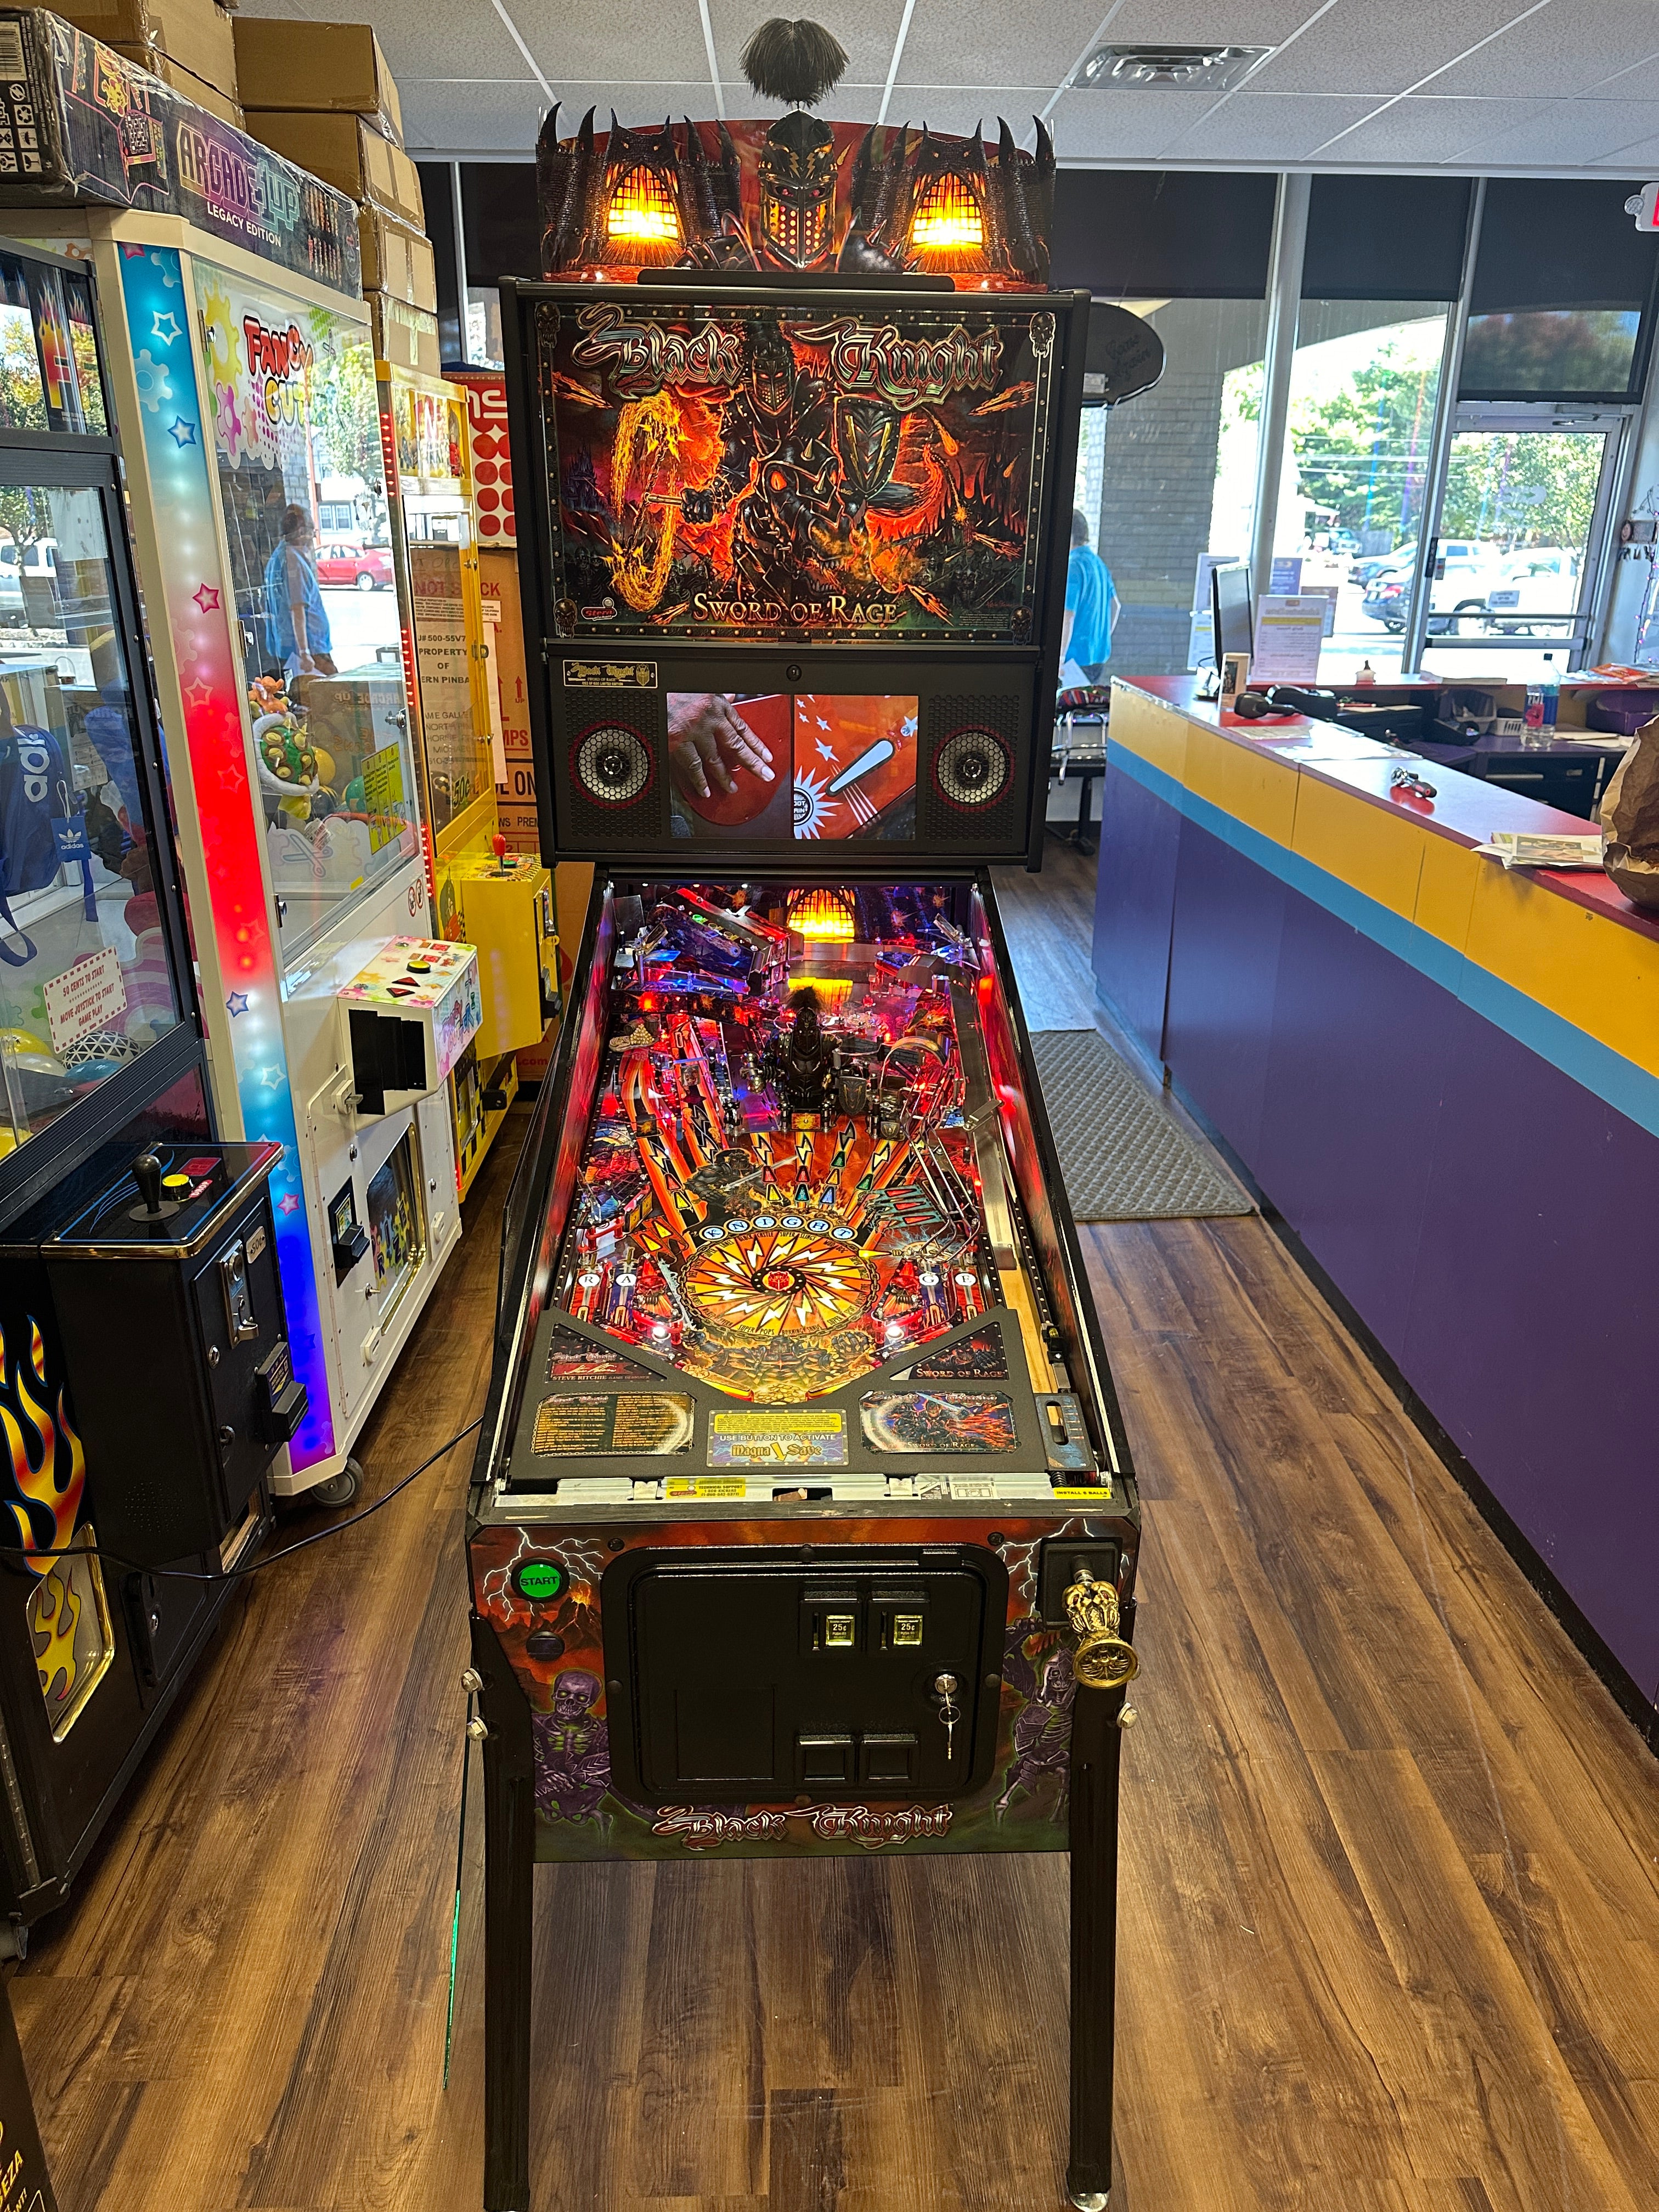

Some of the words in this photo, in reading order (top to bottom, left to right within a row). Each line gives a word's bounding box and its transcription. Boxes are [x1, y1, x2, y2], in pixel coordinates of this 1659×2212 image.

[206, 201, 245, 230] LEGACY
[246, 222, 282, 247] EDITION
[243, 314, 314, 380] FANCY
[571, 302, 743, 399] Black
[789, 315, 1005, 411] Knight
[264, 377, 311, 428] CUT
[692, 592, 782, 621] SWORD
[790, 603, 821, 623] OF
[830, 595, 899, 624] RAGE
[419, 648, 467, 656] PROPERTY
[63, 986, 70, 997] 50
[70, 977, 84, 992] CENTS
[86, 974, 91, 984] TO
[92, 964, 105, 980] START
[60, 1008, 74, 1025] MOVE
[75, 995, 95, 1015] JOYSTICK
[95, 992, 101, 1002] TO
[101, 983, 114, 998] START
[78, 1012, 92, 1027] GAME
[92, 1003, 103, 1018] PLAY
[191, 1181, 210, 1197] DROP
[799, 1233, 817, 1241] SLINGS
[922, 1275, 935, 1283] G
[806, 1323, 823, 1332] SANDS
[826, 1316, 844, 1326] SUPER
[737, 1324, 755, 1333] SUPER
[916, 1368, 955, 1378] SWORD
[973, 1368, 1003, 1378] RAGE
[731, 1444, 771, 1459] Magna
[786, 1443, 823, 1457] Save
[952, 1441, 975, 1449] RAGE
[520, 1576, 558, 1587] START
[833, 1623, 847, 1632] 25¢
[901, 1623, 915, 1632] 25¢
[651, 1804, 789, 1850] Black
[783, 1803, 953, 1849] Knight
